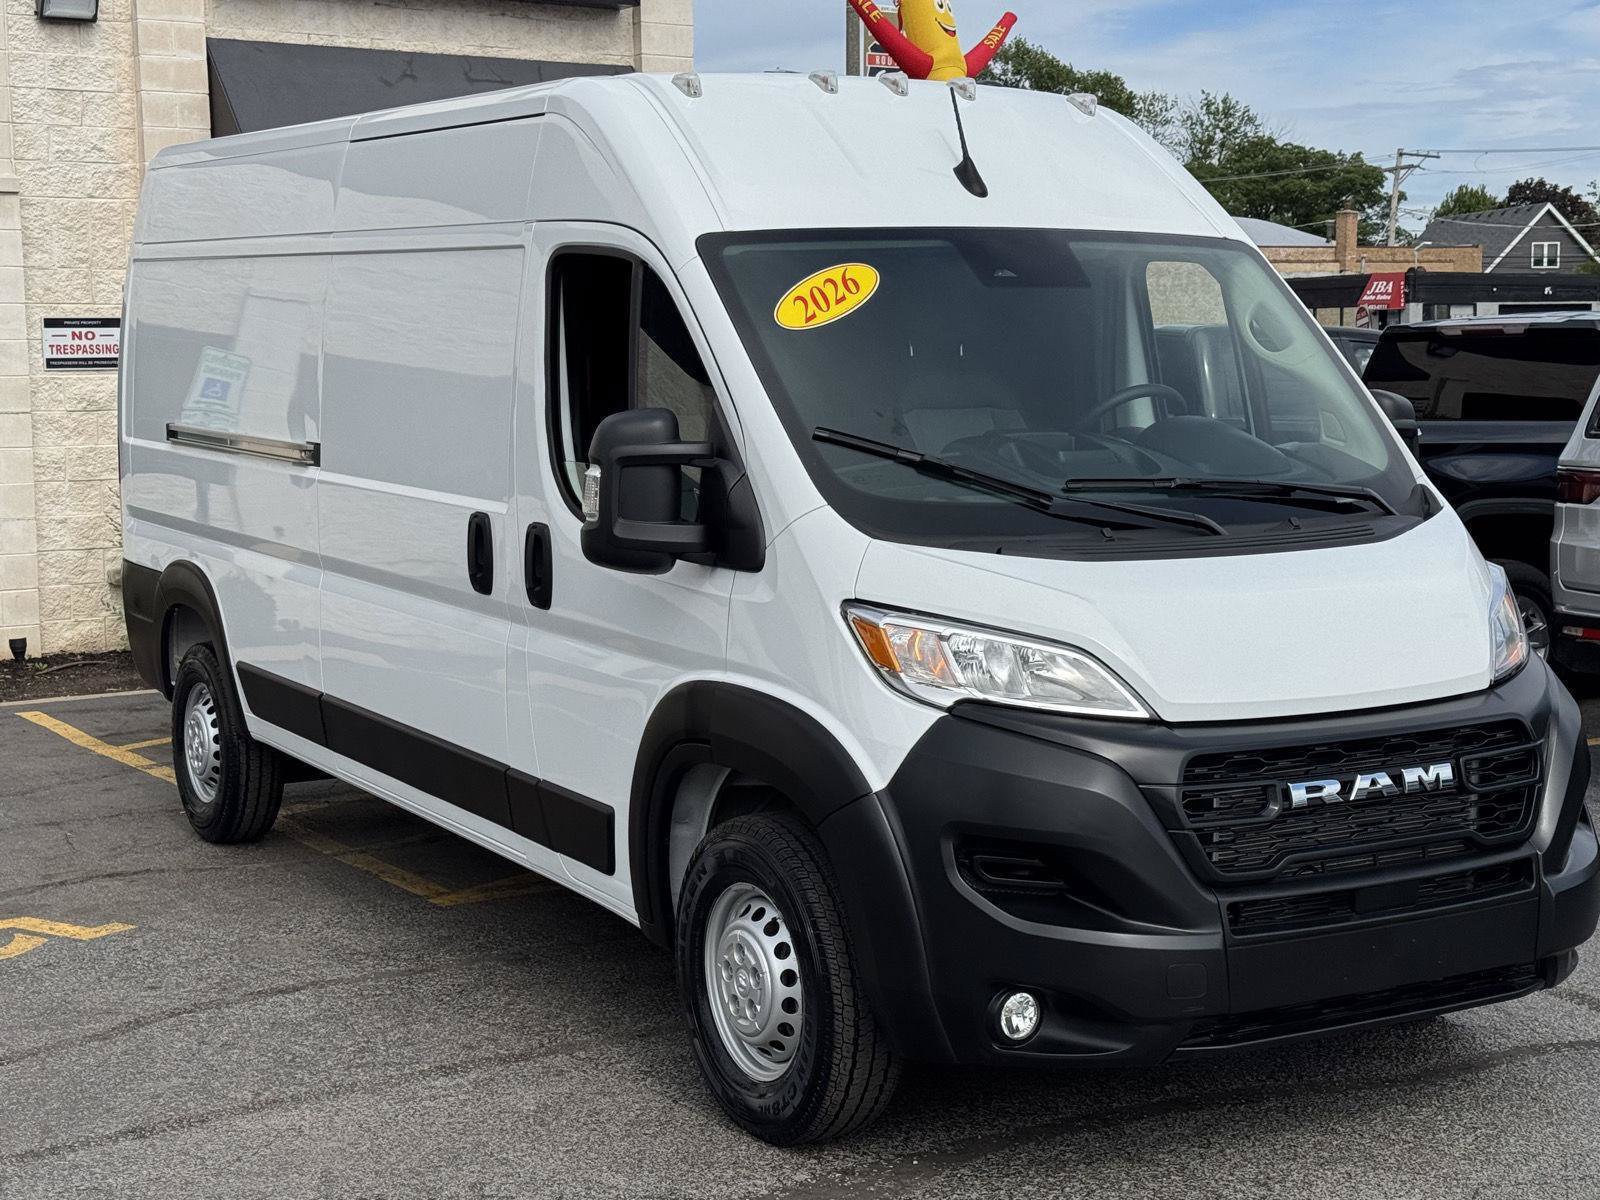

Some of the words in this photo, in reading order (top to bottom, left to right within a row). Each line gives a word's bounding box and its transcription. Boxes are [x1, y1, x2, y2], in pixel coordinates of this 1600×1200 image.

[984, 24, 1007, 49] SALE
[793, 268, 860, 324] 2026
[1367, 281, 1393, 295] JBA
[71, 331, 96, 340] NO
[48, 344, 119, 355] TRESPASSING
[1287, 763, 1453, 808] RAM
